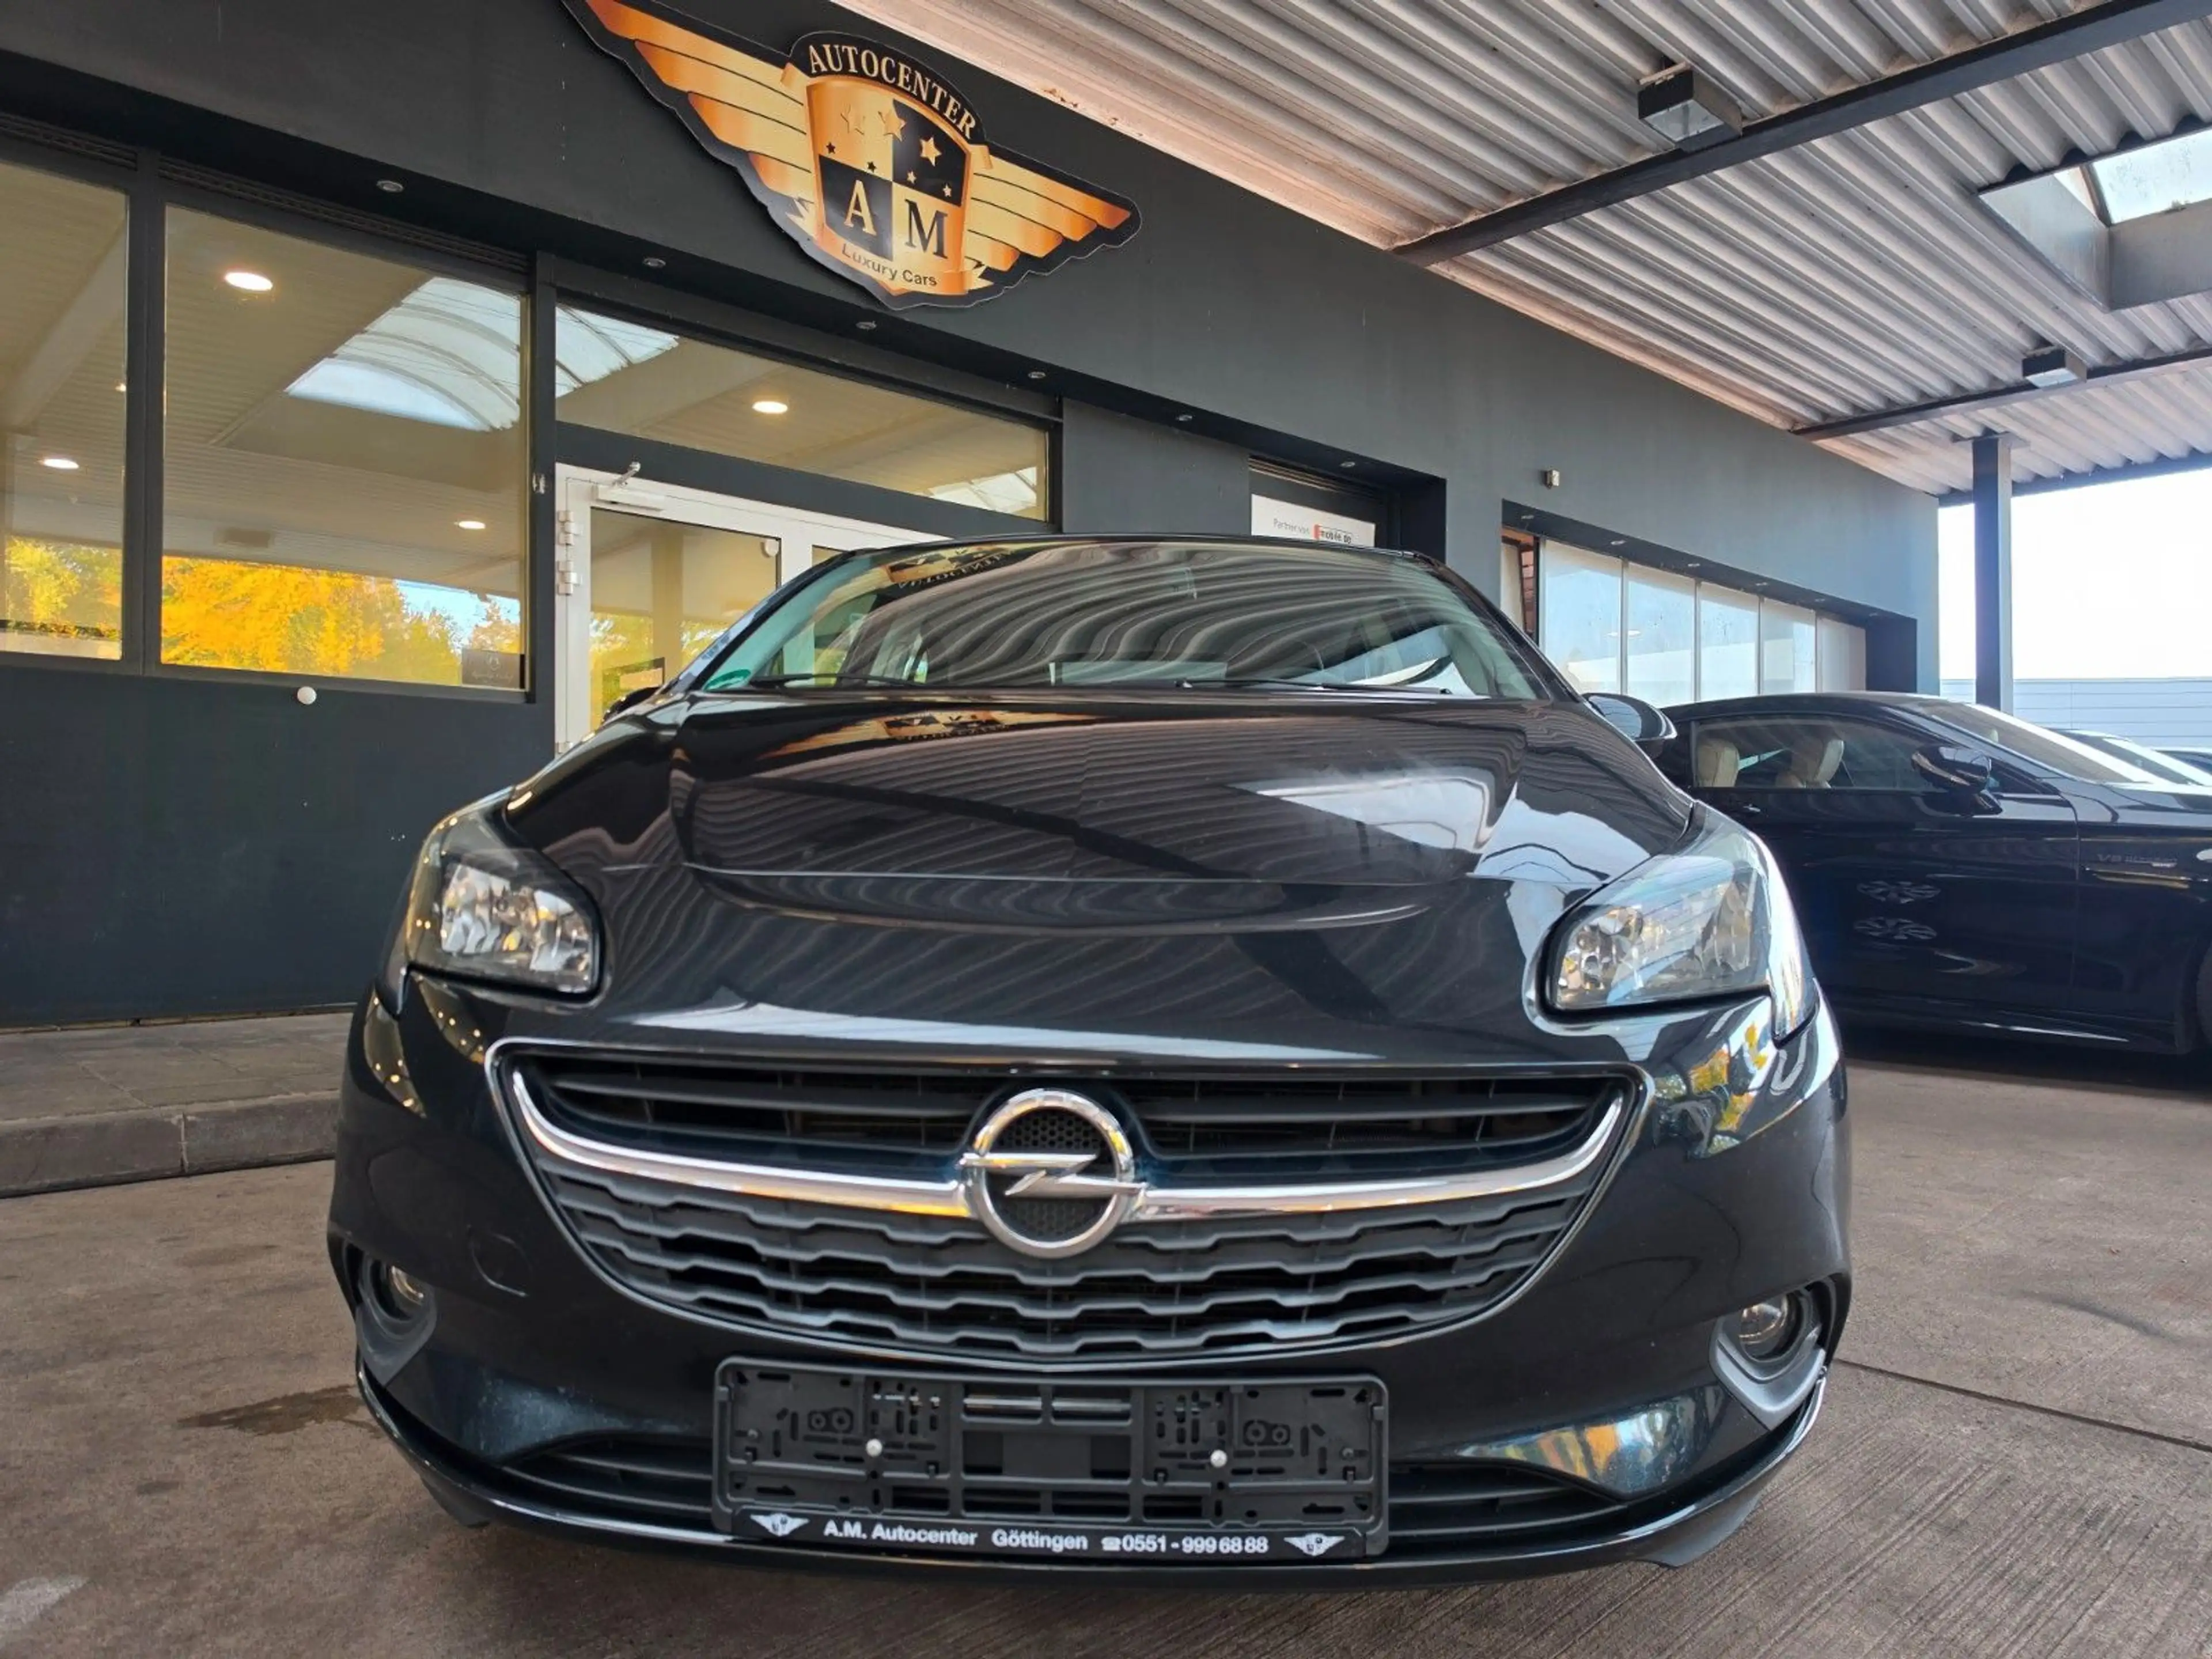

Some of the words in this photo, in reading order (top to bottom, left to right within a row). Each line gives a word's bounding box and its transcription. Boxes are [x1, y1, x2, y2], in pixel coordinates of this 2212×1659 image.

[809, 44, 976, 139] AUTOCENTER
[844, 180, 877, 236] A
[904, 199, 948, 259] M
[841, 243, 898, 281] Luxury
[902, 268, 937, 286] Cars
[824, 1520, 867, 1539] A.M.
[871, 1522, 979, 1545] Autocenter
[991, 1528, 1088, 1552] Göttingen
